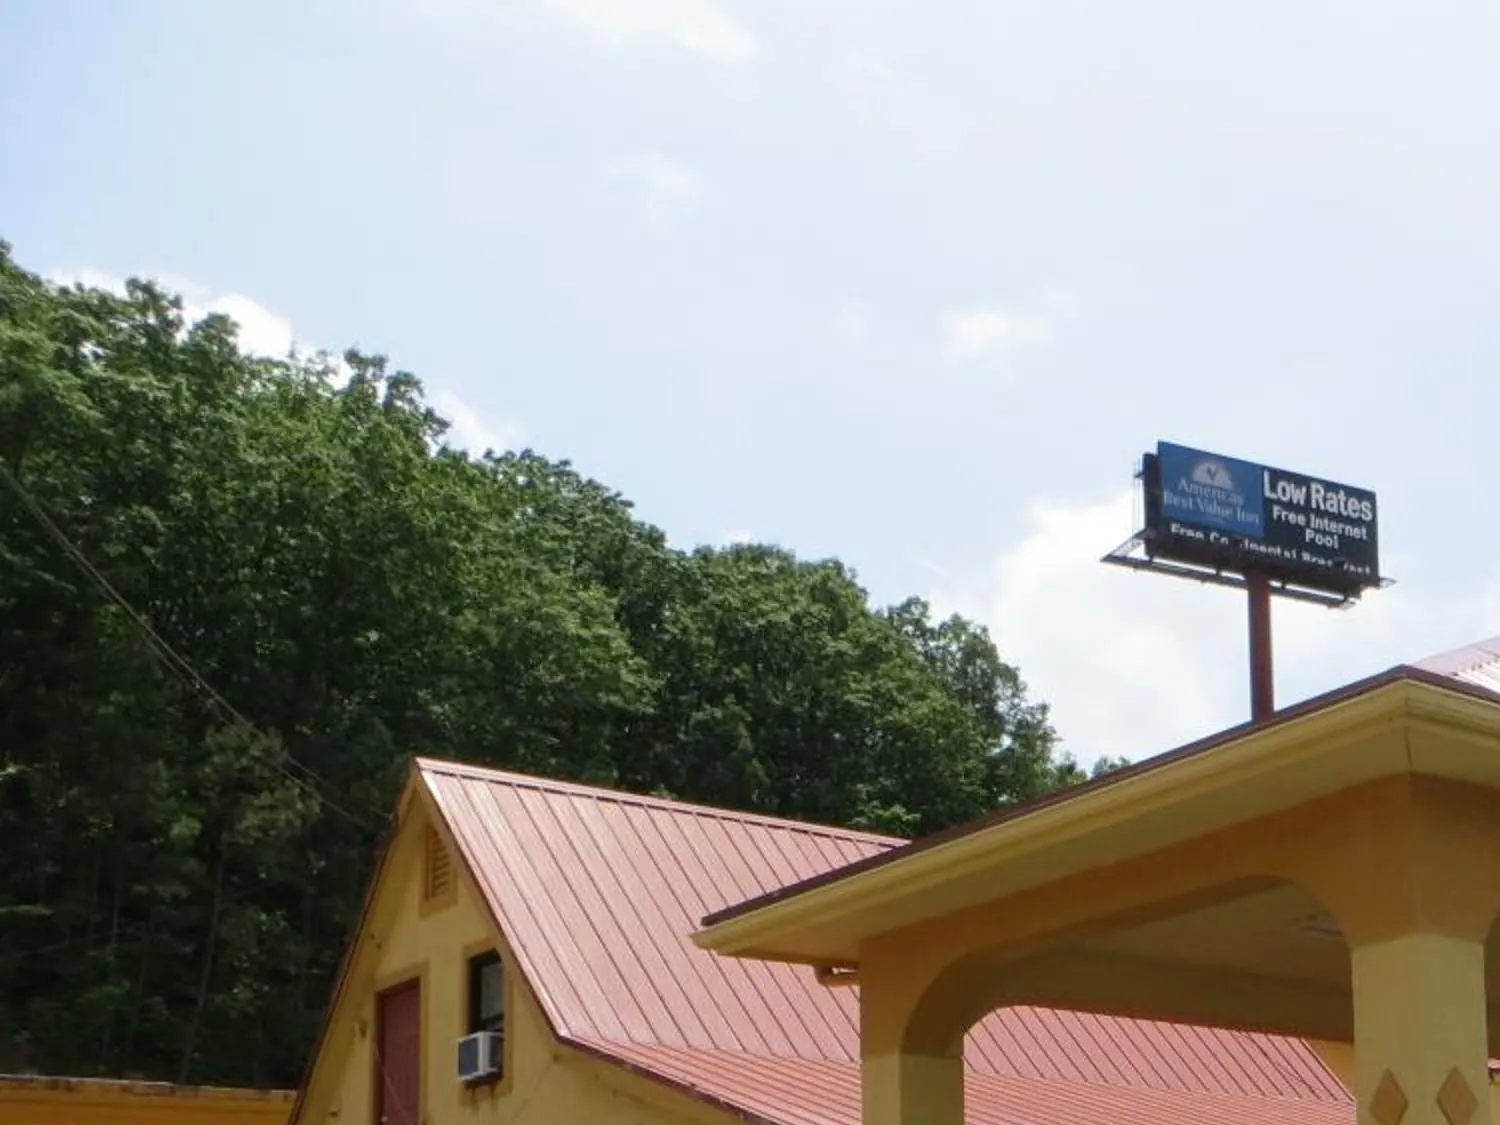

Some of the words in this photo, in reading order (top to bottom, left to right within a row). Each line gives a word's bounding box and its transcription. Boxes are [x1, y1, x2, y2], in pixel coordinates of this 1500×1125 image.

[1263, 470, 1306, 506] Low
[1311, 482, 1373, 521] Rates
[1273, 505, 1306, 527] Free
[1310, 514, 1368, 541] Internet
[1305, 529, 1339, 550] Pool
